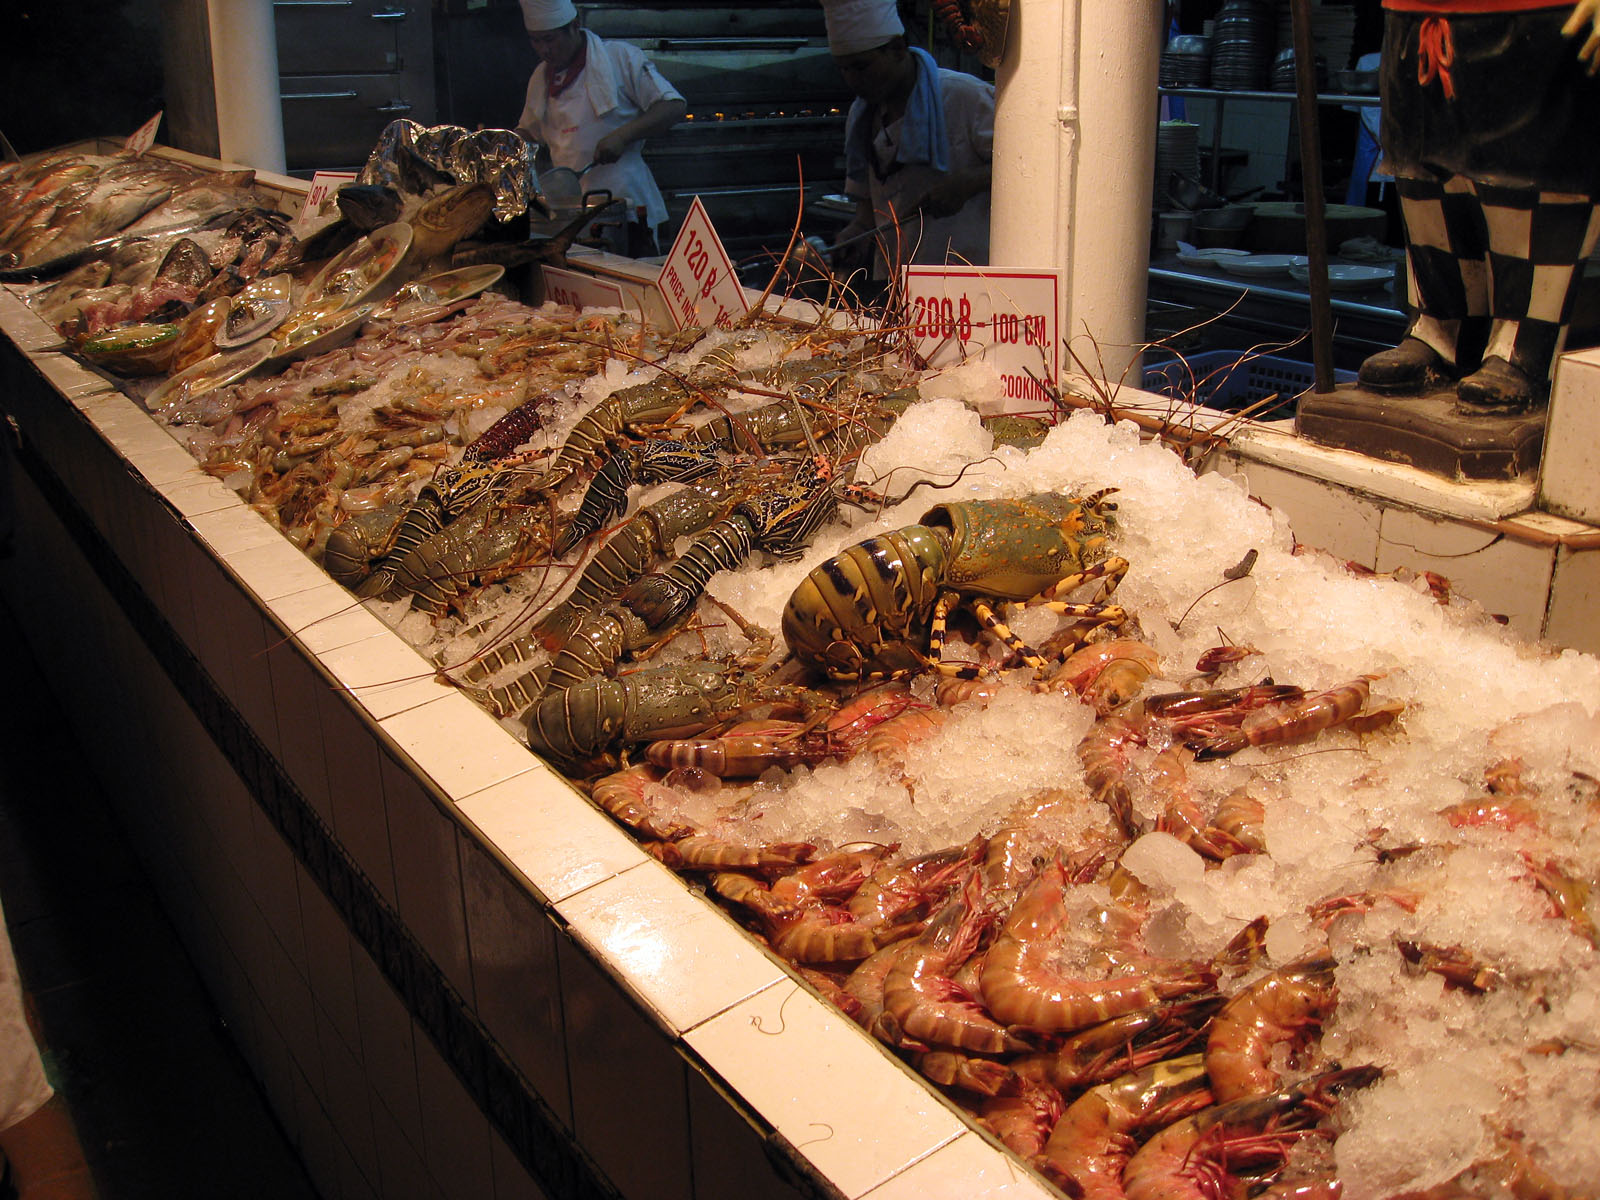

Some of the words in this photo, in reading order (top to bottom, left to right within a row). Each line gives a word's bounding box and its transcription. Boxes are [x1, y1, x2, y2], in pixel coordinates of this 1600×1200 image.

[684, 230, 709, 281] 120
[666, 266, 685, 303] PRICE
[914, 296, 953, 339] 200
[993, 313, 1018, 344] 100
